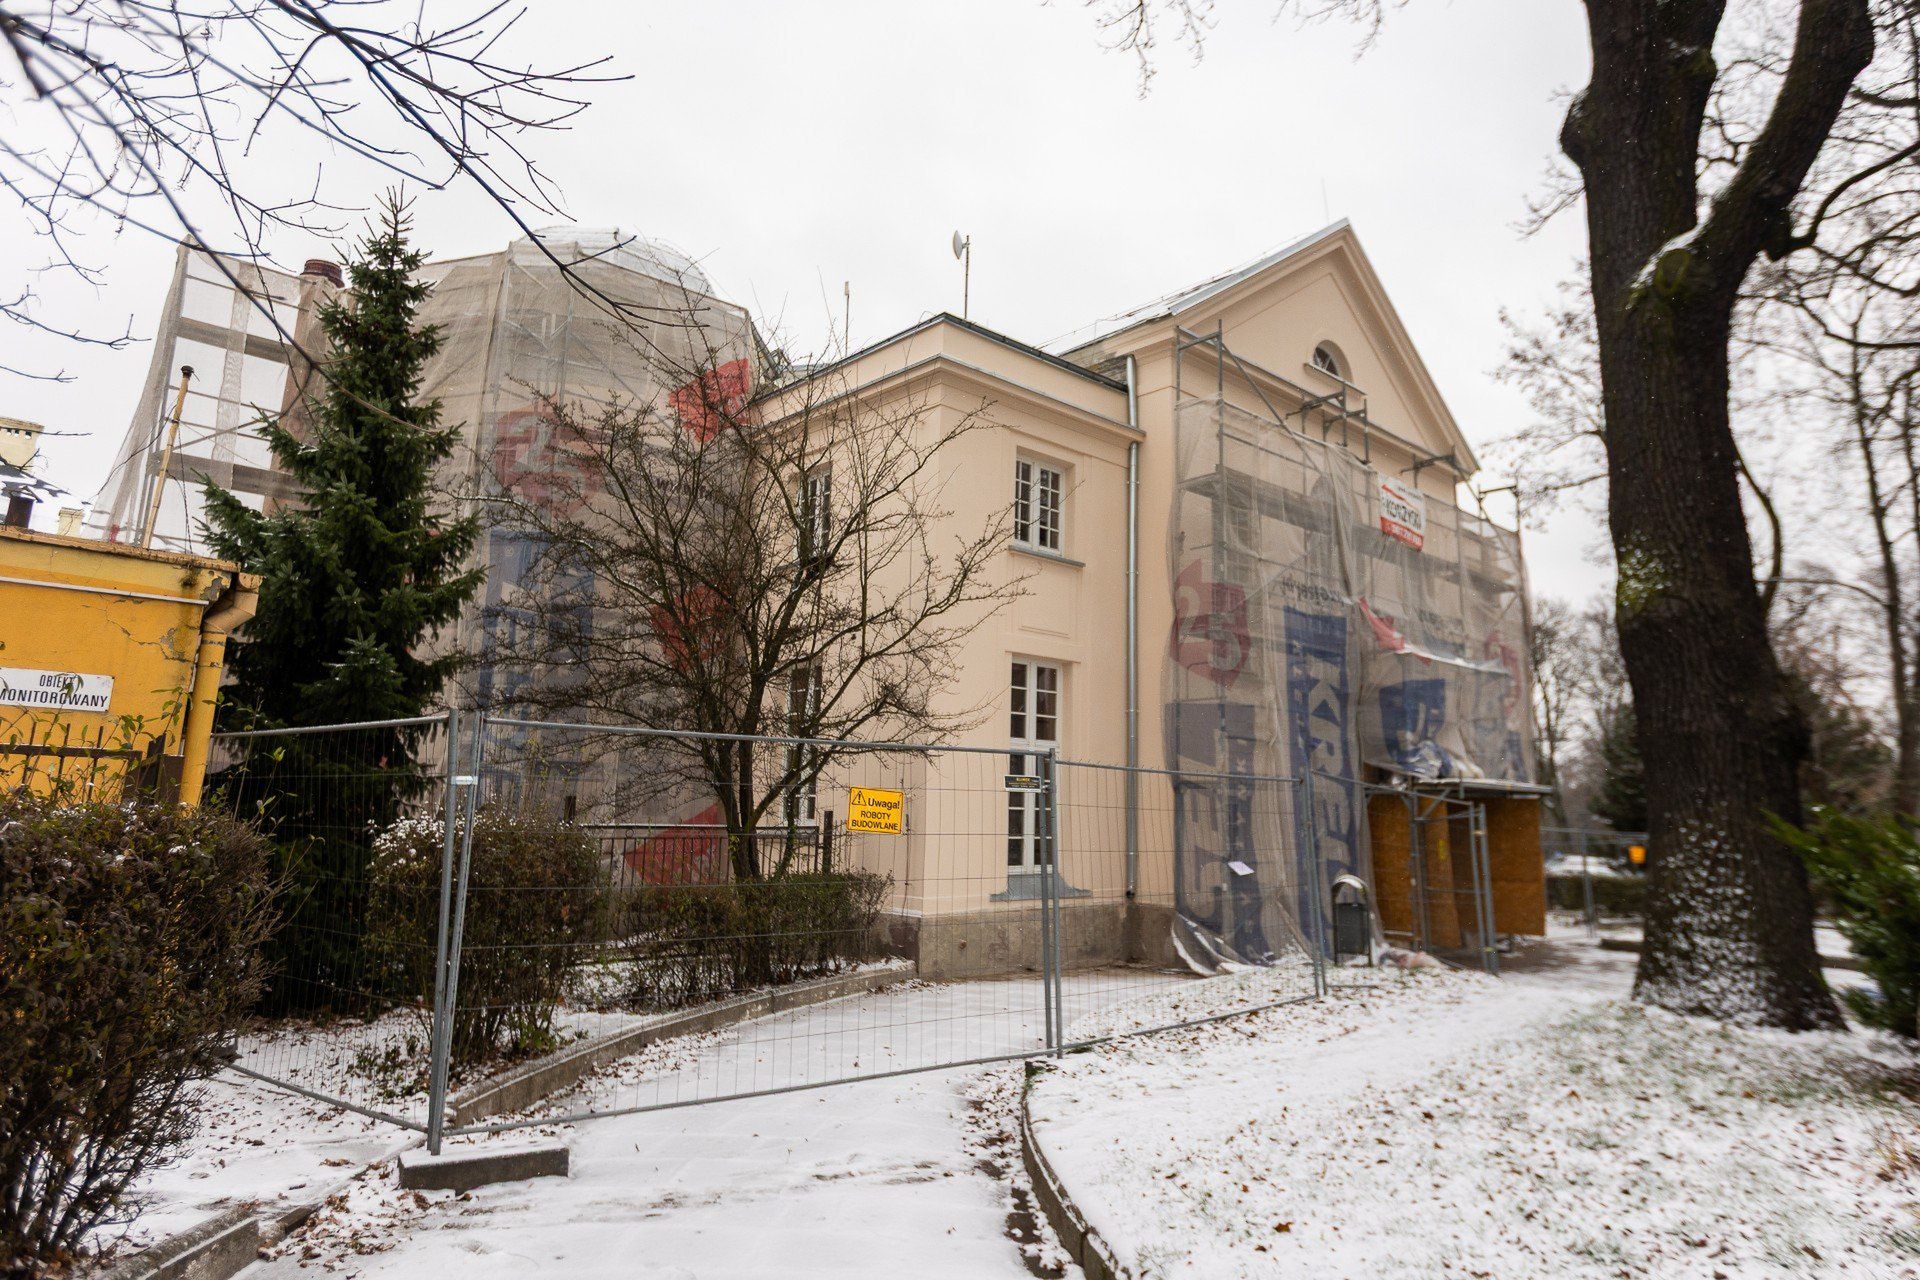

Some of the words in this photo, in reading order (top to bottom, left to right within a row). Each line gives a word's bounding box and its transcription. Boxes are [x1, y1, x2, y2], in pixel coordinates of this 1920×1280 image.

[1176, 585, 1242, 671] 25
[40, 674, 75, 688] OBIEKT
[868, 798, 899, 810] Uwaga!
[860, 810, 891, 820] ROBOTY
[851, 819, 899, 831] BUDOWLANE
